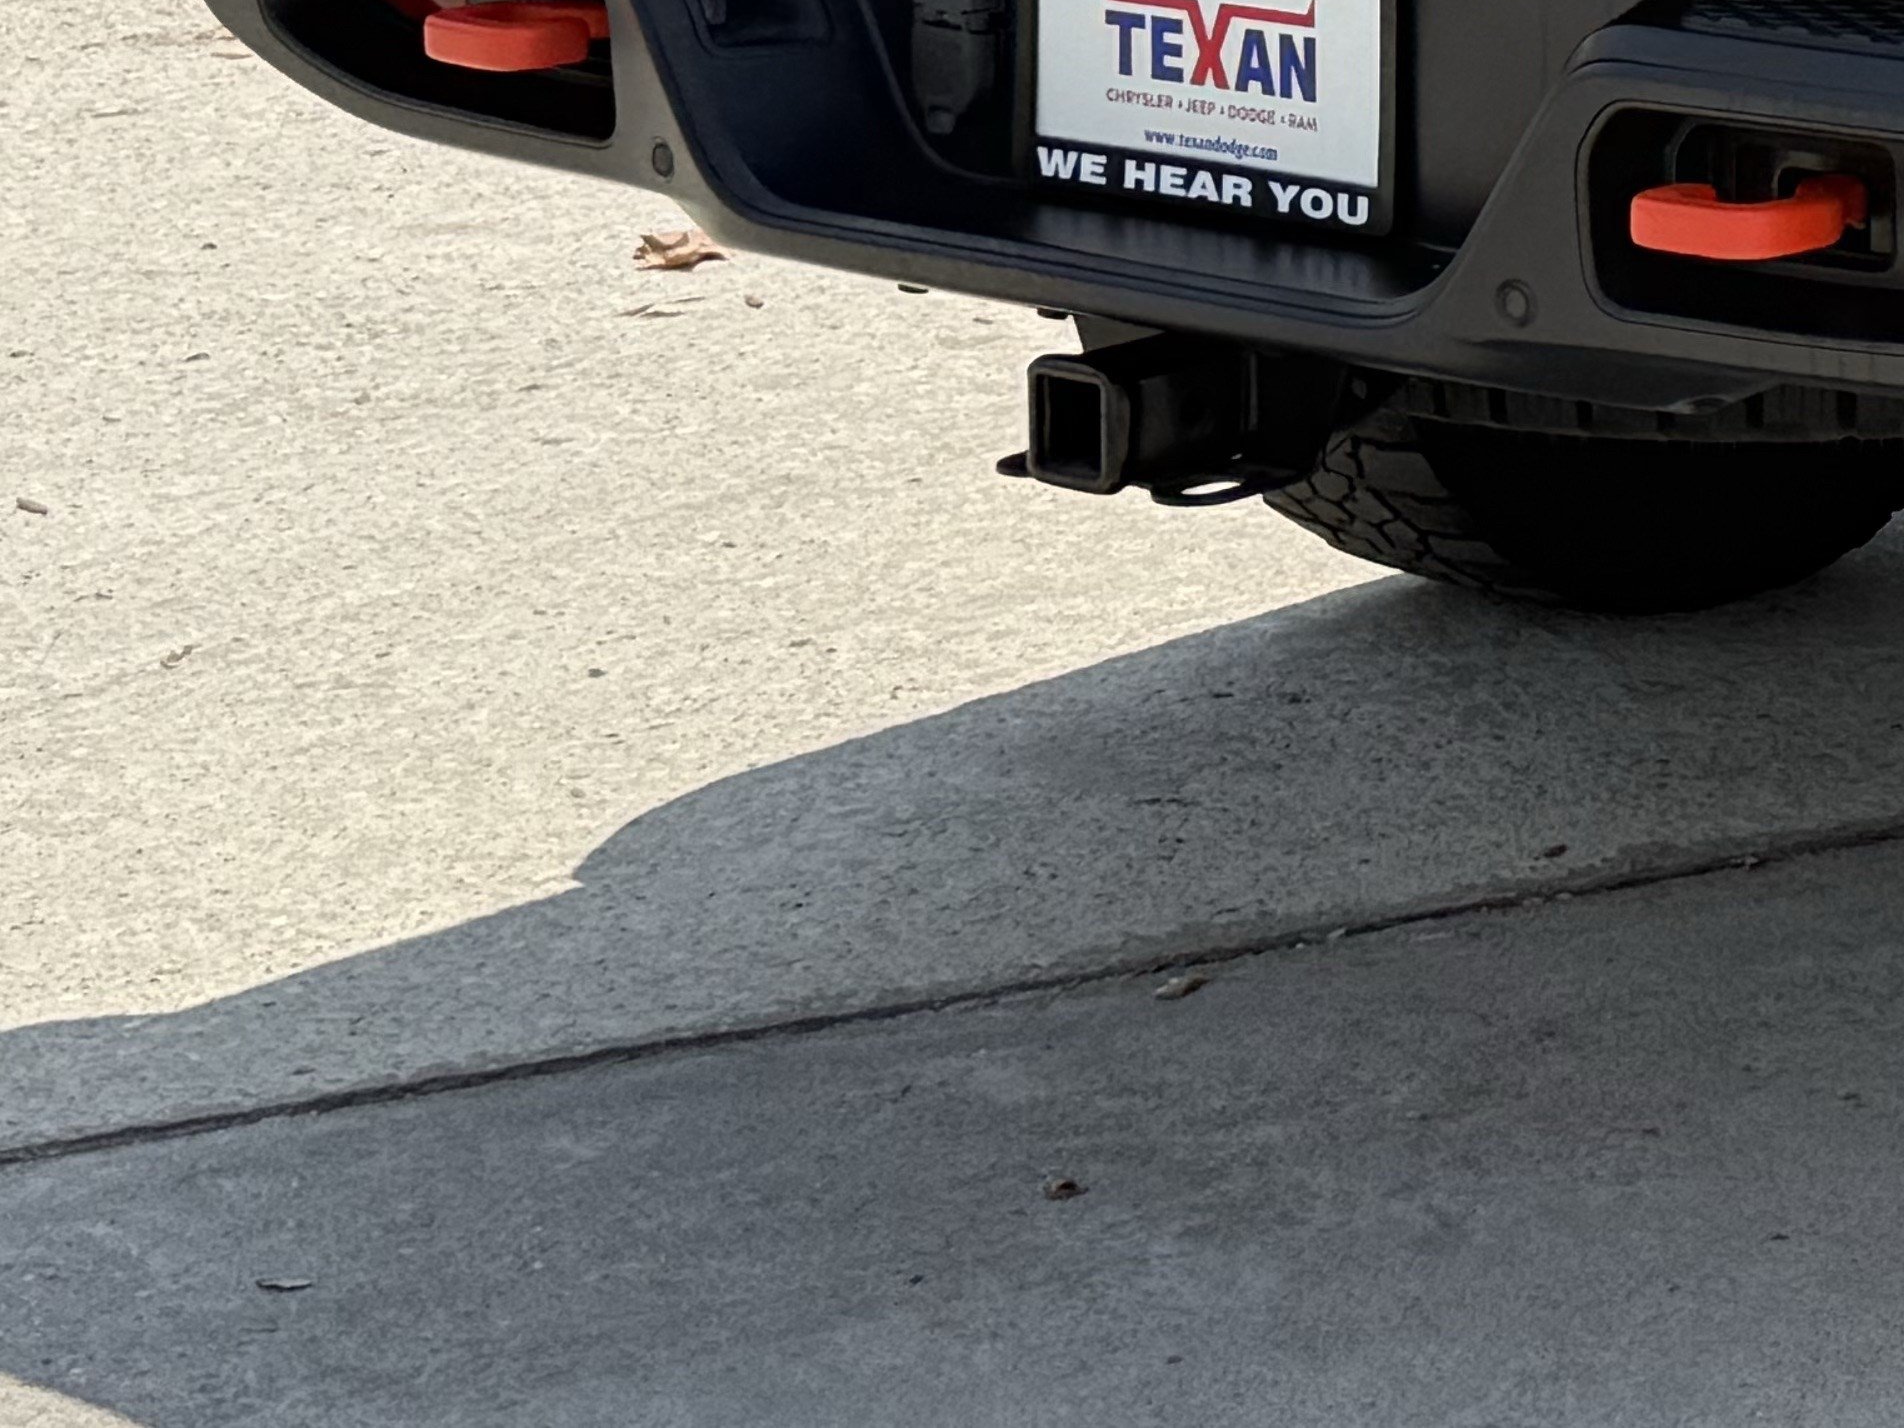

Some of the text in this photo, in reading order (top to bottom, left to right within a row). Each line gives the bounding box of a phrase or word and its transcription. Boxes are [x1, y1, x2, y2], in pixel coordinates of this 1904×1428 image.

[1106, 87, 1318, 133] CHRYSLER JEEP DODGE RAM
[1143, 128, 1279, 162] www.texandodge.com
[1037, 145, 1370, 226] WE HEAR YOU
